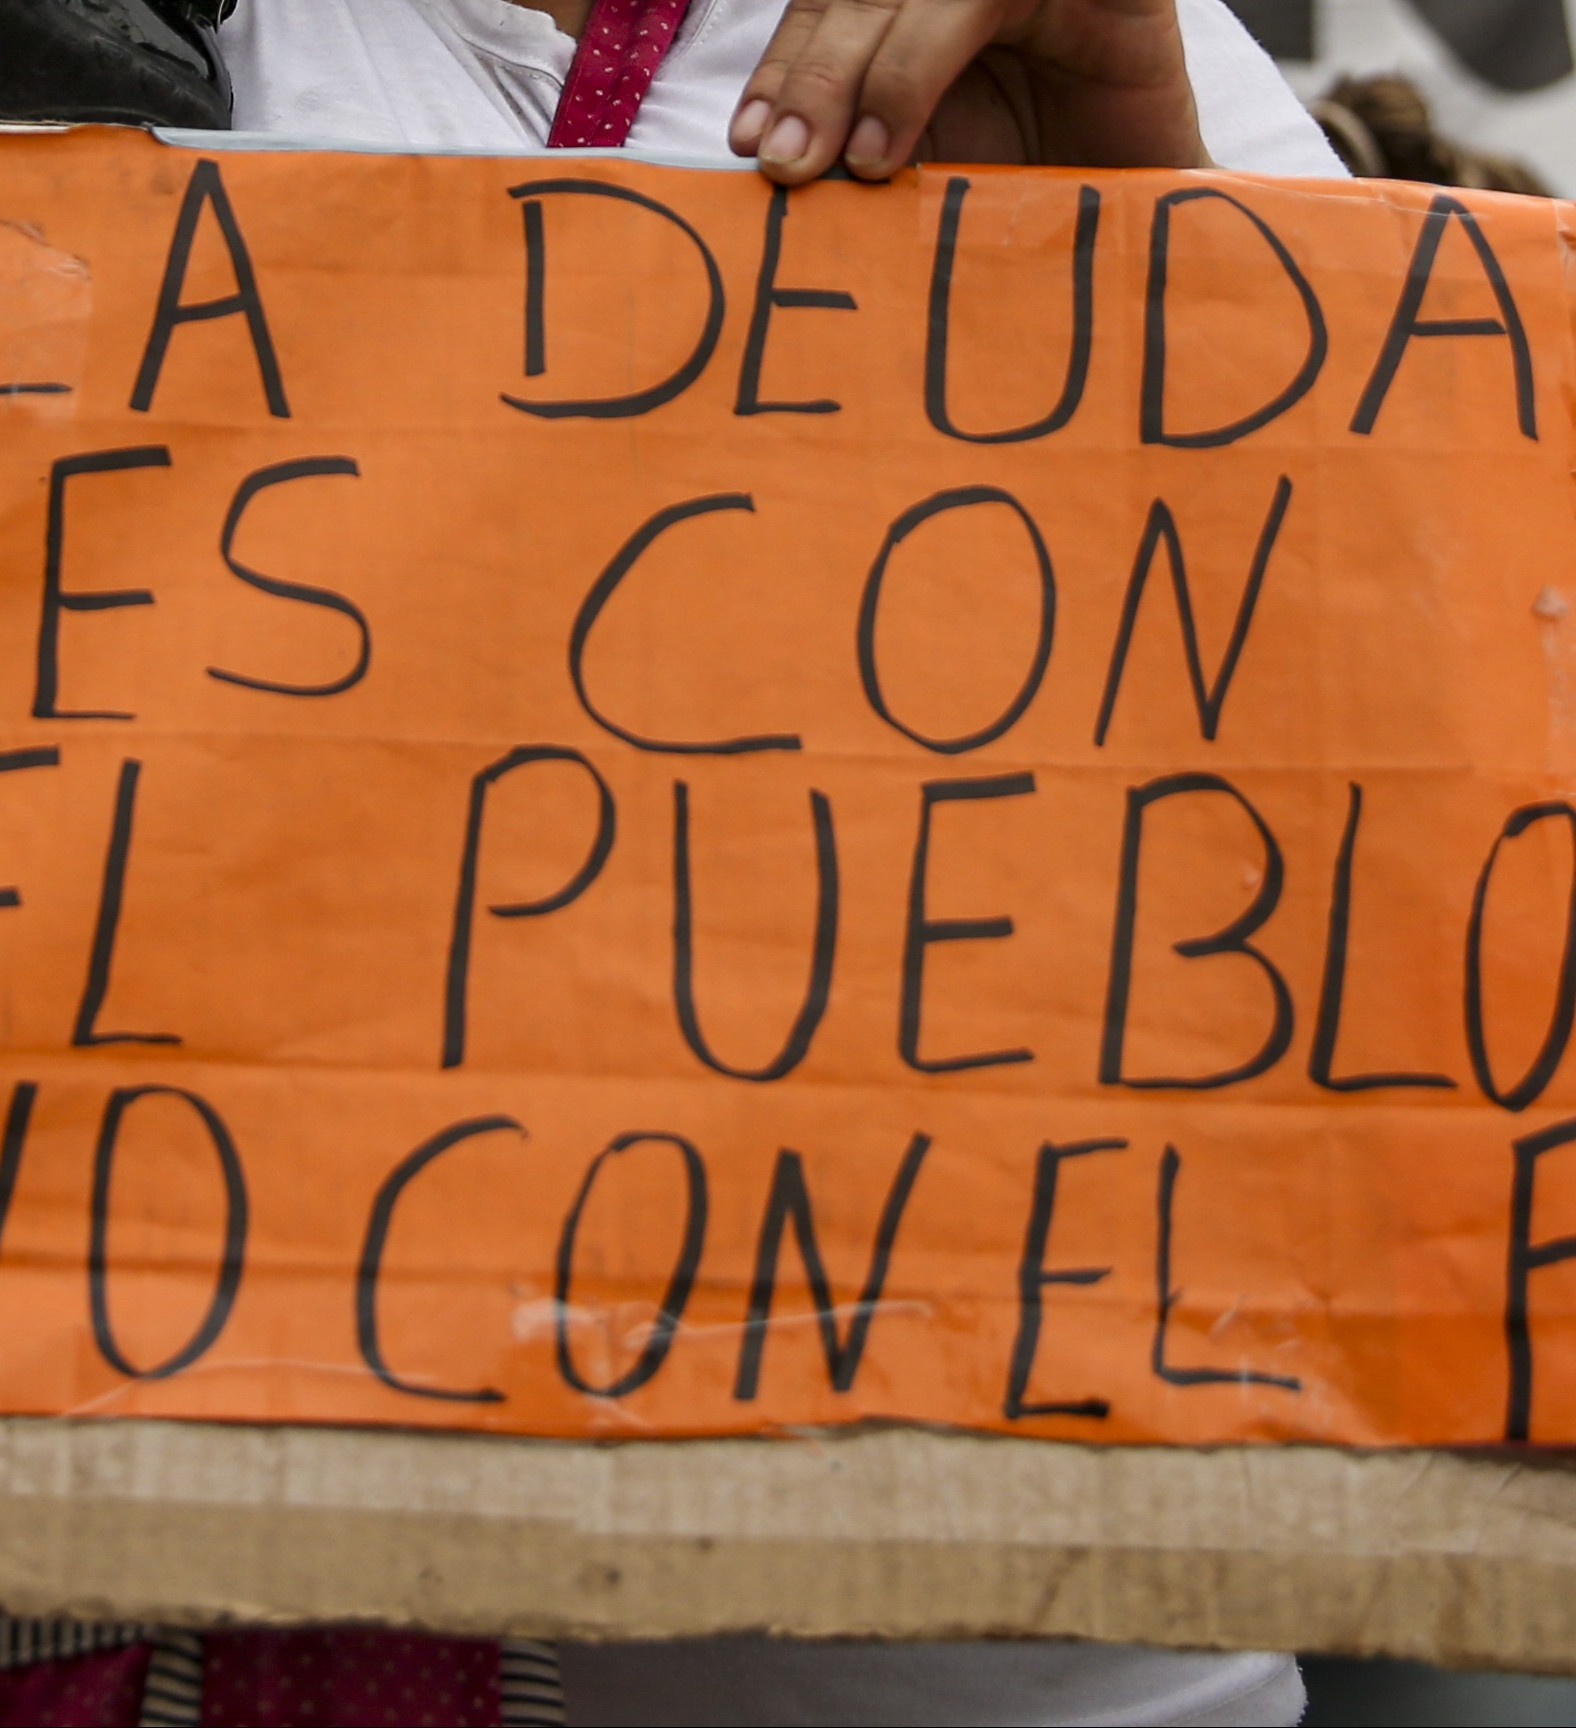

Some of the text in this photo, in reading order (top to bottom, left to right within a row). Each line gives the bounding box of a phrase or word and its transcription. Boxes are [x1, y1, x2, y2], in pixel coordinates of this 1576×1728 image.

[500, 173, 1540, 449] DEUDA
[31, 445, 1293, 756] ES CON
[355, 1116, 932, 1404] CON
[1002, 1138, 1302, 1421] EL
